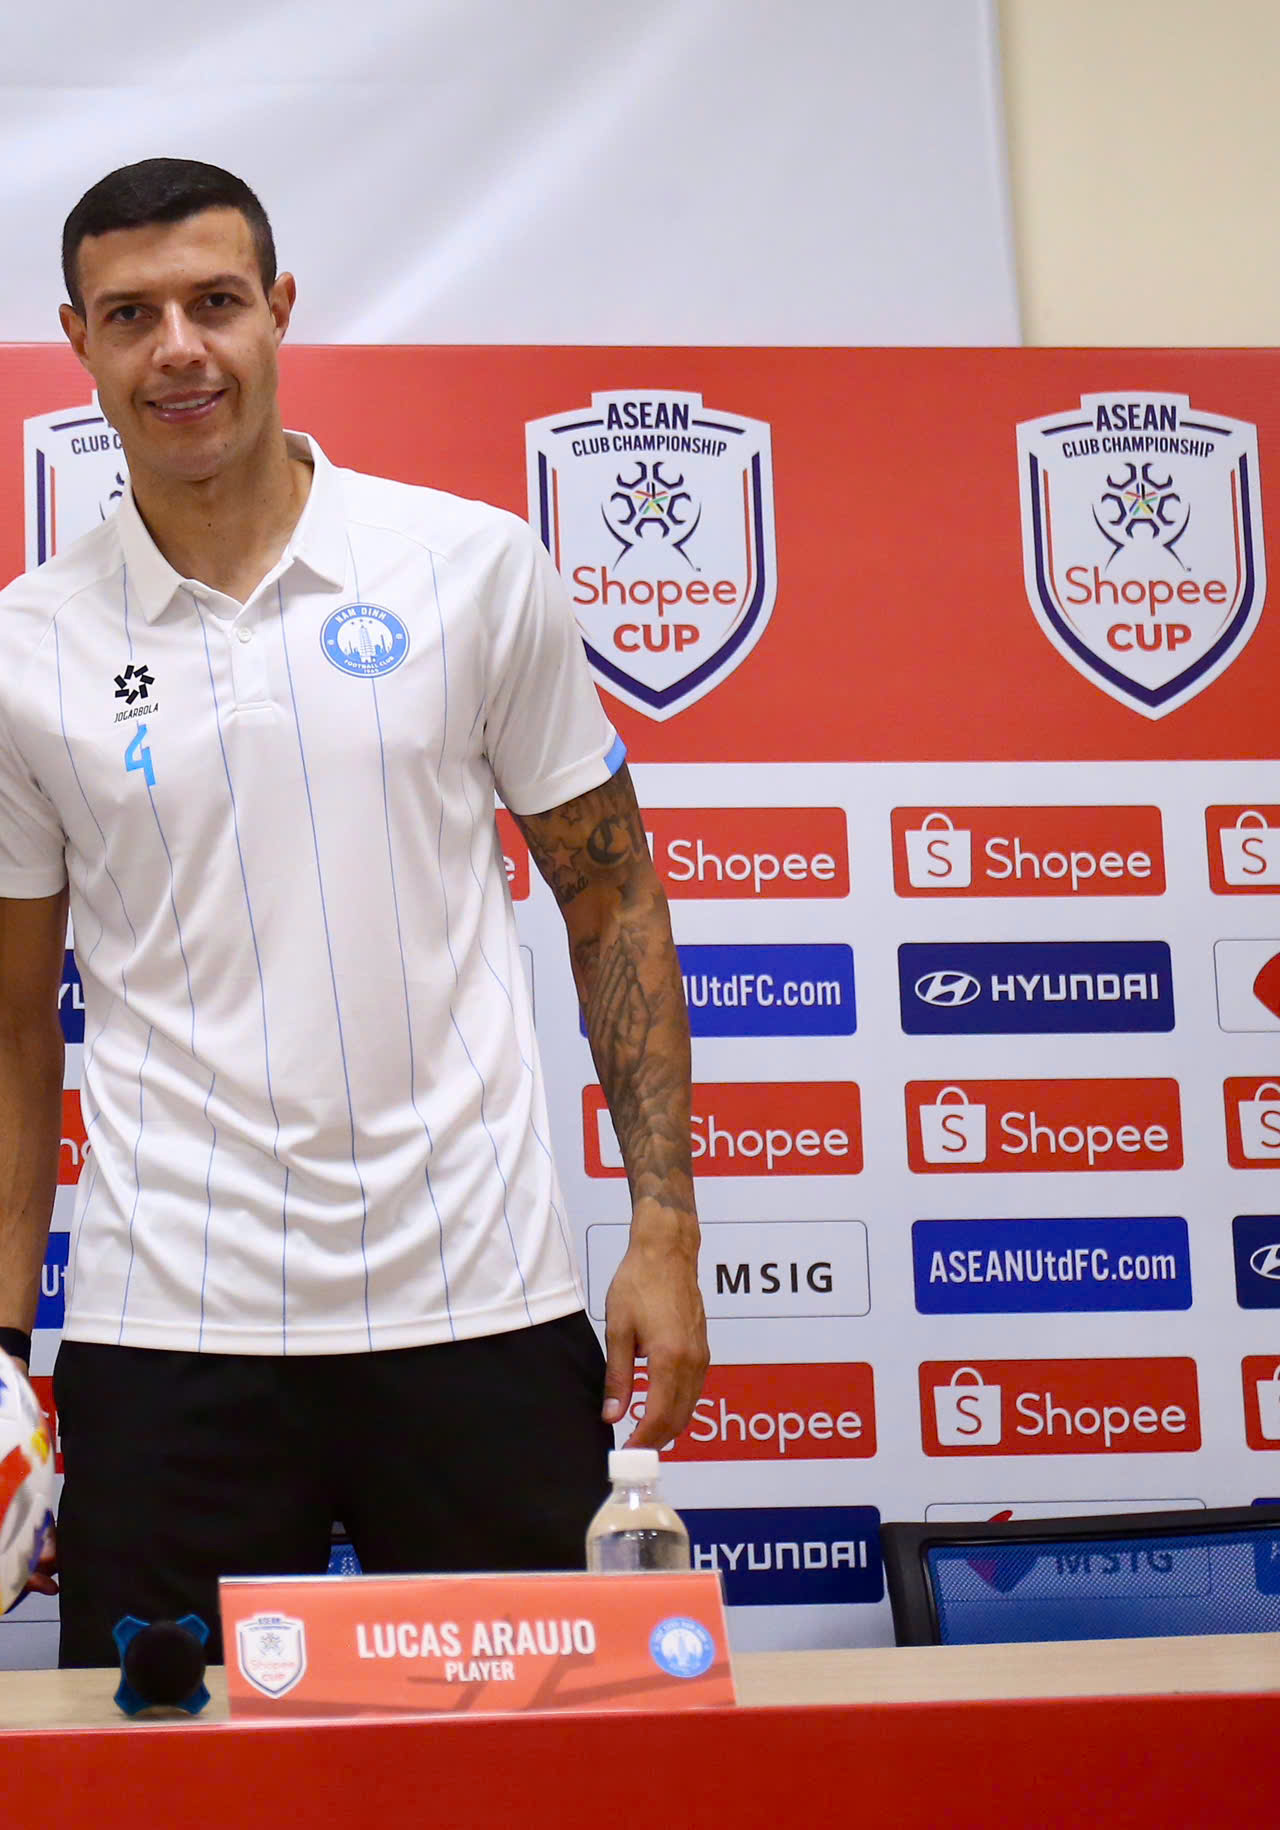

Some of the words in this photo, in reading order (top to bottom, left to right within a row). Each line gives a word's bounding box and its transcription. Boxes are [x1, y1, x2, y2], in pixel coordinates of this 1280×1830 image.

[608, 402, 688, 430] ASEAN
[1097, 404, 1176, 432] ASEAN
[72, 435, 110, 454] CLUB
[572, 437, 609, 456] CLUB
[613, 435, 727, 456] CHAMPIONSHIP
[1063, 439, 1099, 458] CLUB
[1102, 436, 1214, 457] CHAMPIONSHIP
[573, 566, 736, 617] Shopee
[1065, 566, 1227, 616] Shopee
[334, 607, 357, 624] NAM
[360, 606, 388, 621] DINH
[614, 624, 699, 652] CUP
[1107, 624, 1191, 651] CUP
[114, 702, 159, 723] JOGARBOLA
[124, 723, 156, 786] 4
[668, 840, 835, 892] Shopee
[986, 838, 1151, 890] Shopee
[992, 974, 1158, 1001] HYUNDAI
[691, 1115, 849, 1169] Shopee
[1001, 1112, 1168, 1165] Shopee
[716, 1262, 832, 1294] MSIG
[930, 1249, 1175, 1282] ASEANUtdFC.com
[690, 1398, 861, 1453] Shopee
[1016, 1392, 1186, 1447] Shopee
[693, 1544, 866, 1570] HYUNDAI
[357, 1623, 461, 1658] LUCAS
[472, 1620, 595, 1656] ARAUJO
[445, 1660, 515, 1682] PLAYER
